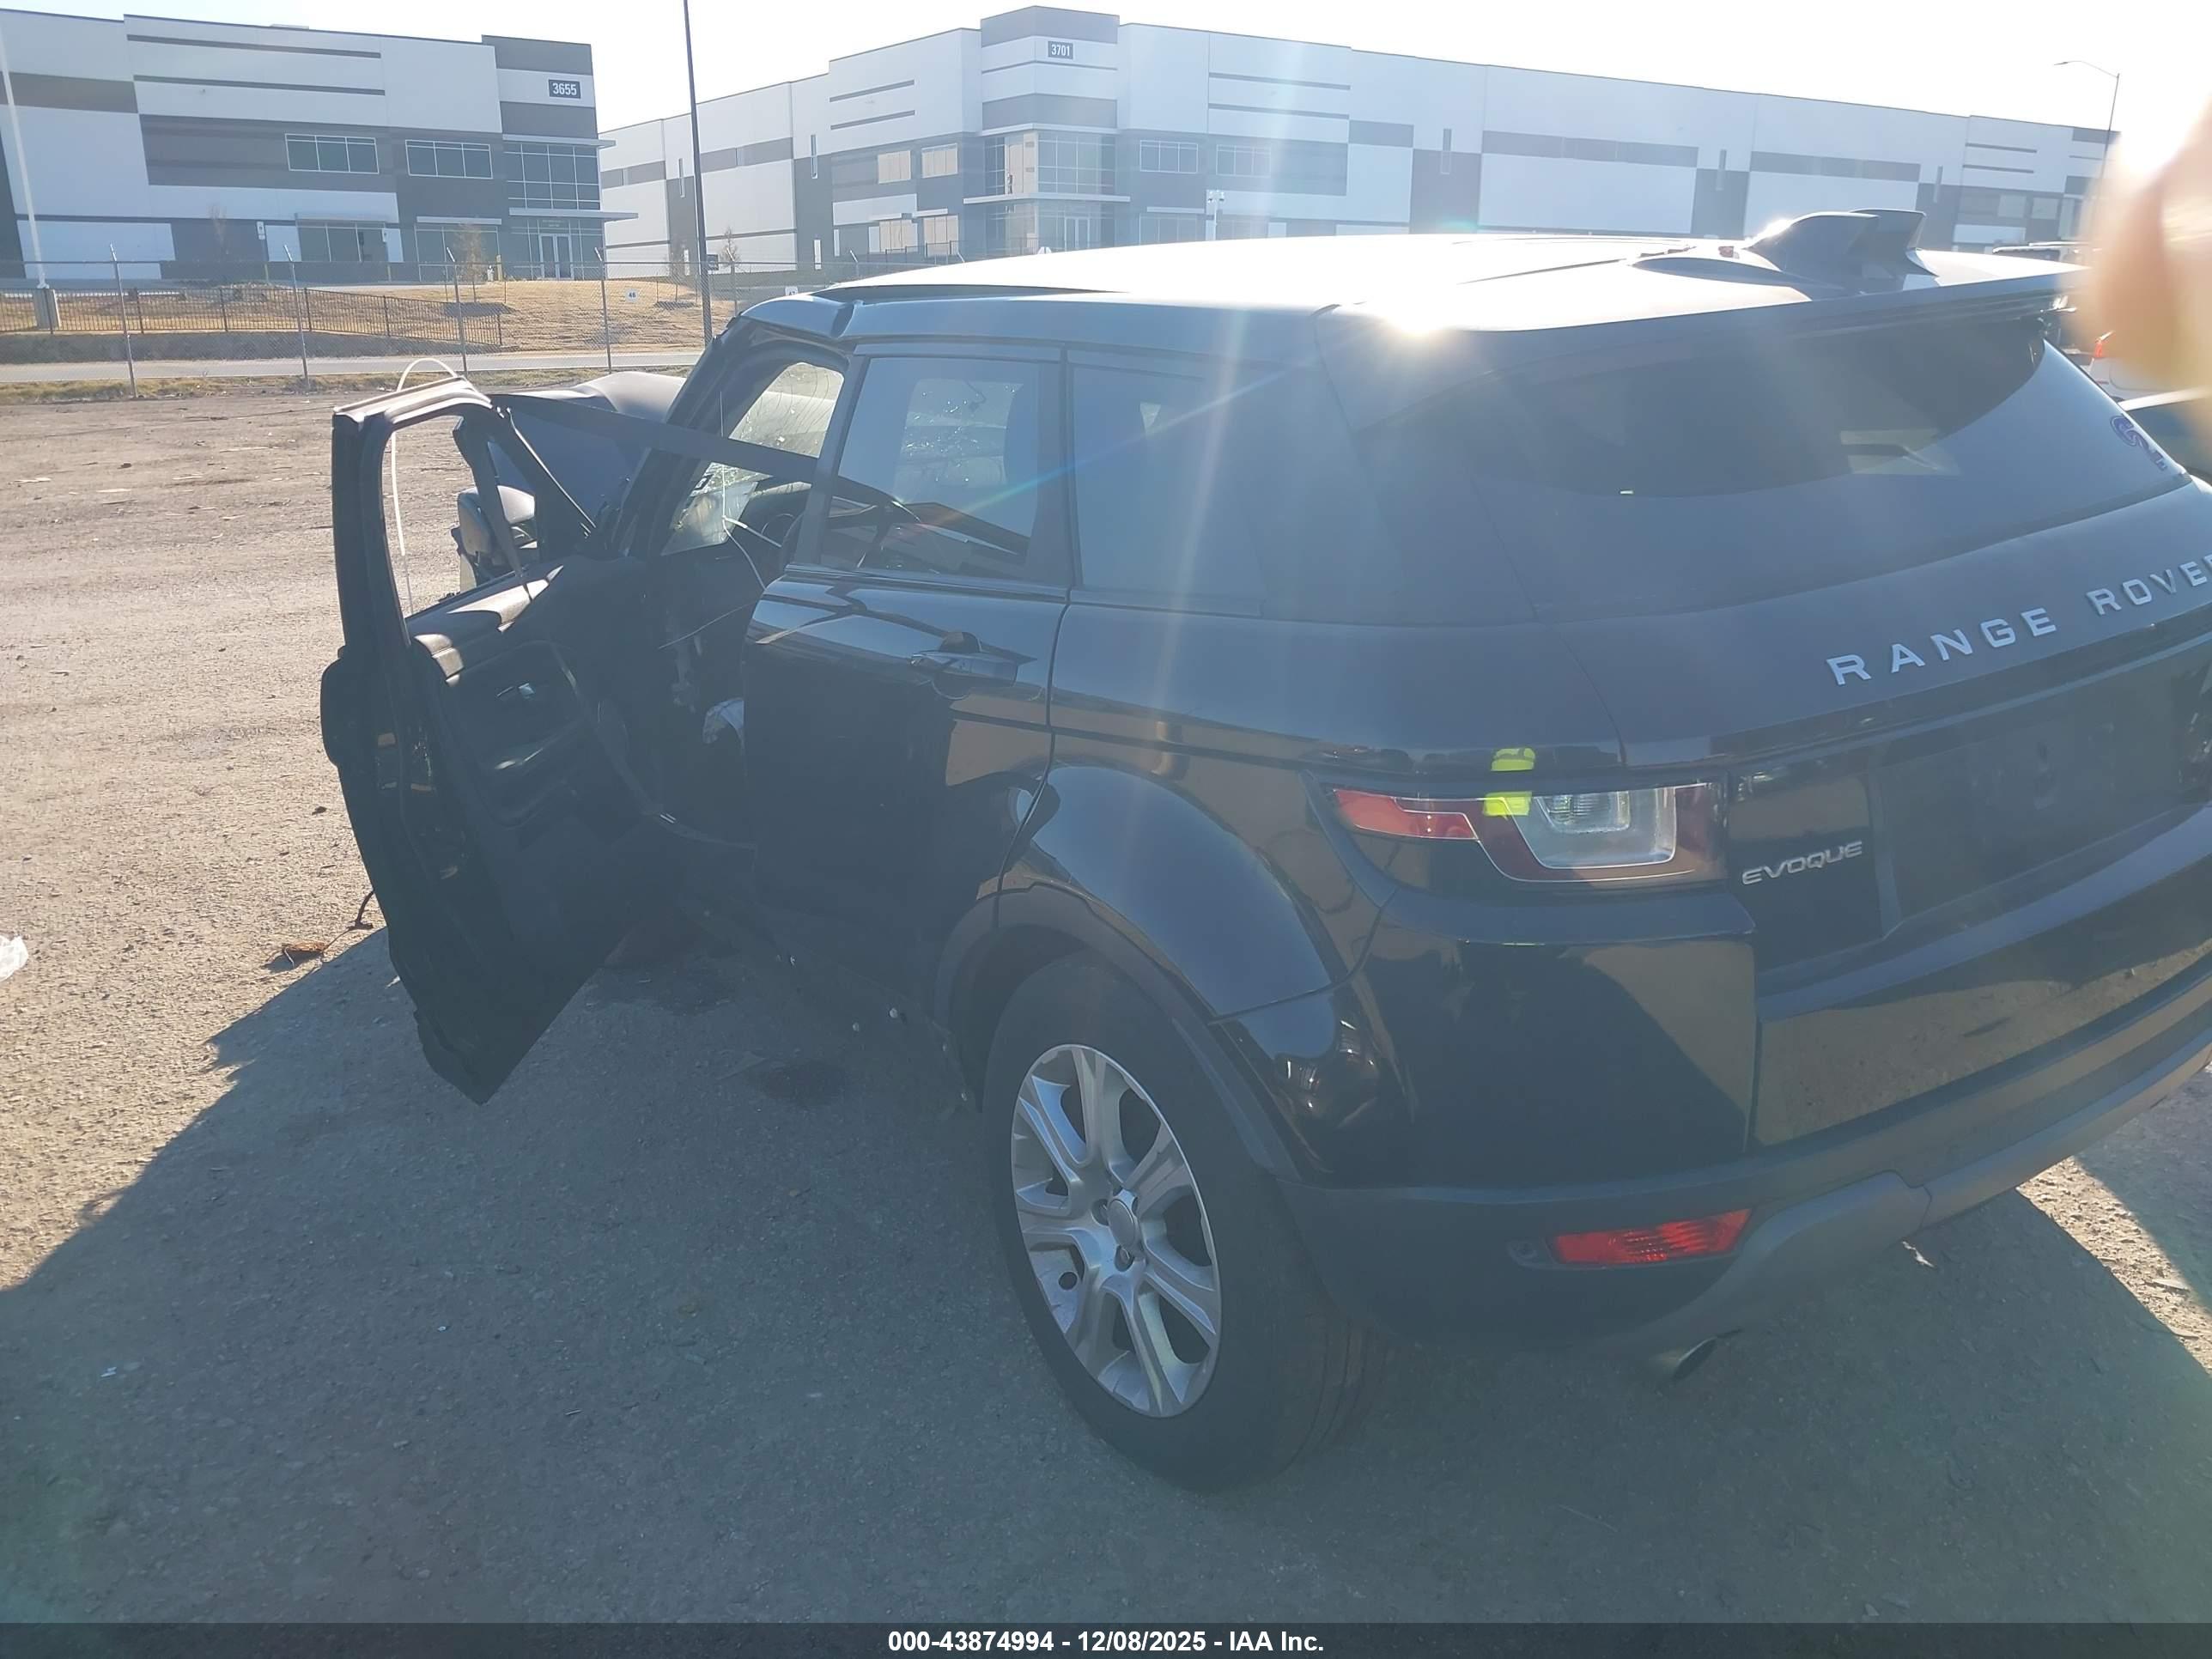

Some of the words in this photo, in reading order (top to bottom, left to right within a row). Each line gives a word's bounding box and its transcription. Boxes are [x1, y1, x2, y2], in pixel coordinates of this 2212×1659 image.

[1051, 44, 1070, 57] 3701
[552, 82, 577, 96] 3655
[1826, 607, 2057, 686] RANGE
[2086, 554, 2212, 616] ROVE
[1741, 841, 1863, 885] EVOQUE
